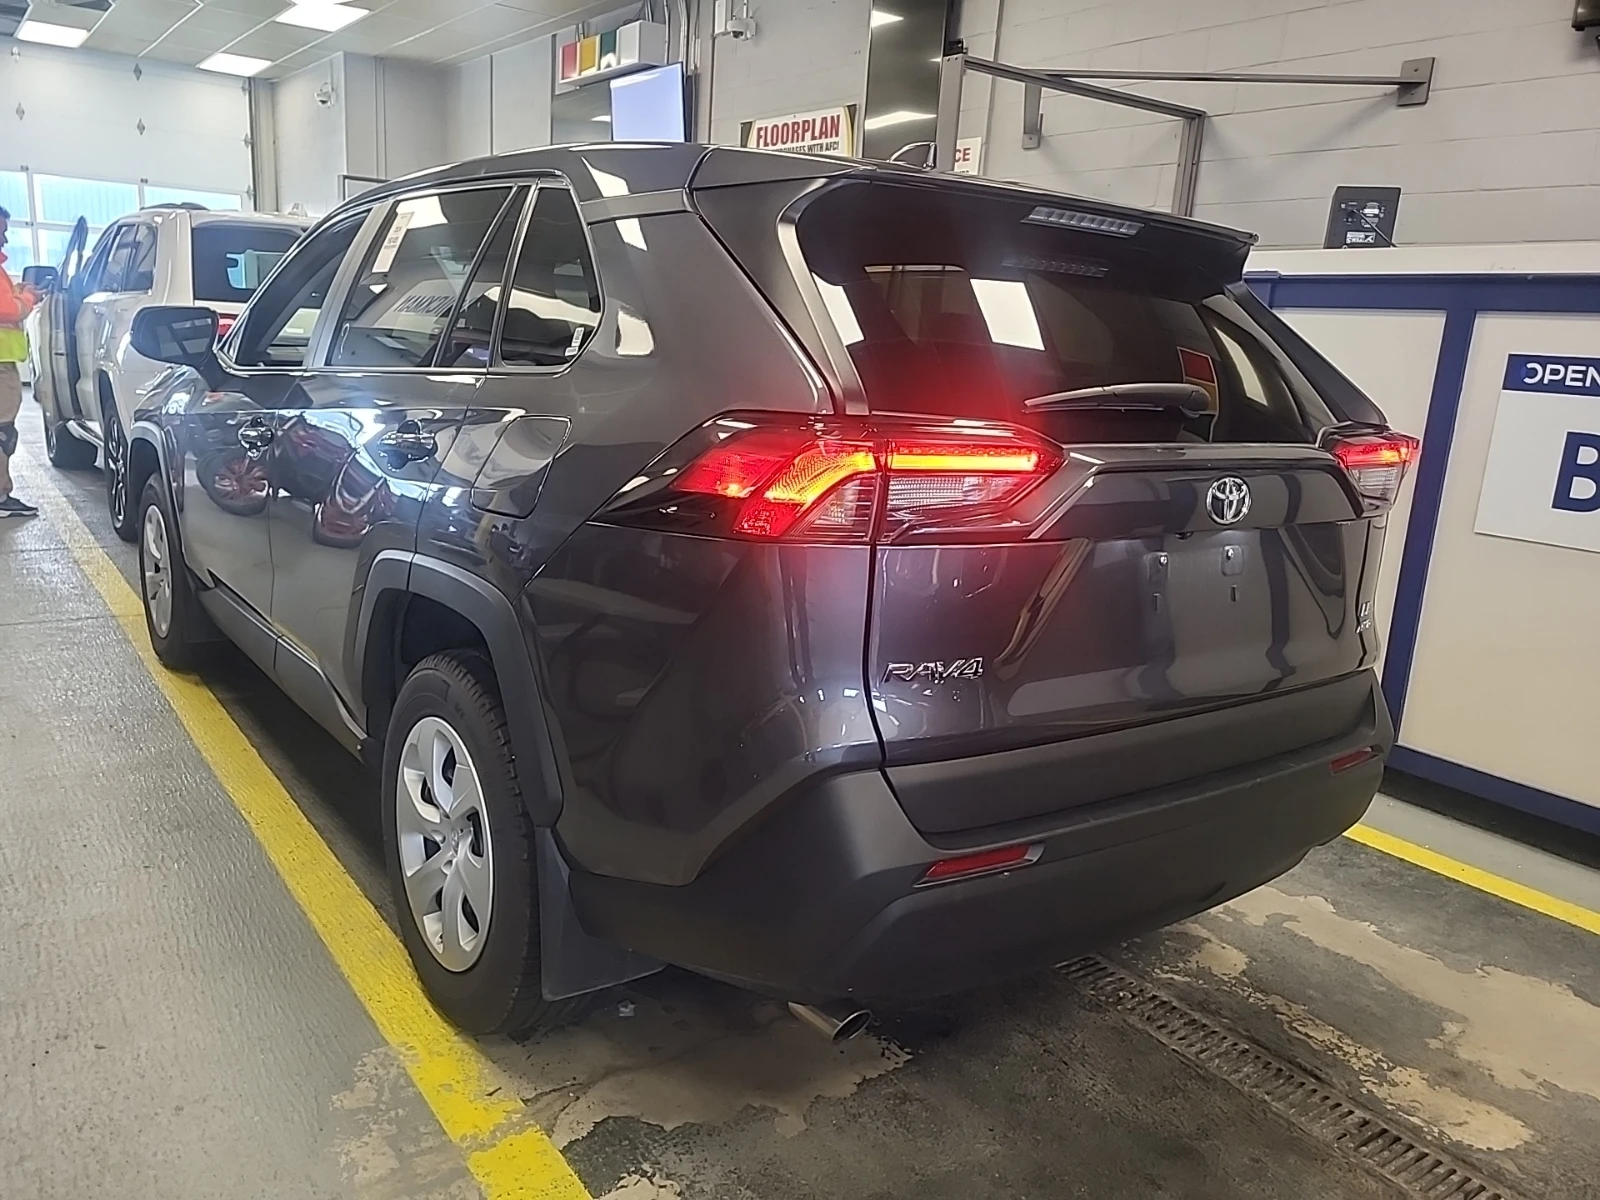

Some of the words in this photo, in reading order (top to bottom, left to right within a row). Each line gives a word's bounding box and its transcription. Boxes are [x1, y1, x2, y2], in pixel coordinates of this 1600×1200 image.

[756, 114, 840, 148] FLOORPLAN
[807, 143, 824, 153] WITH
[881, 656, 984, 684] RAV4
